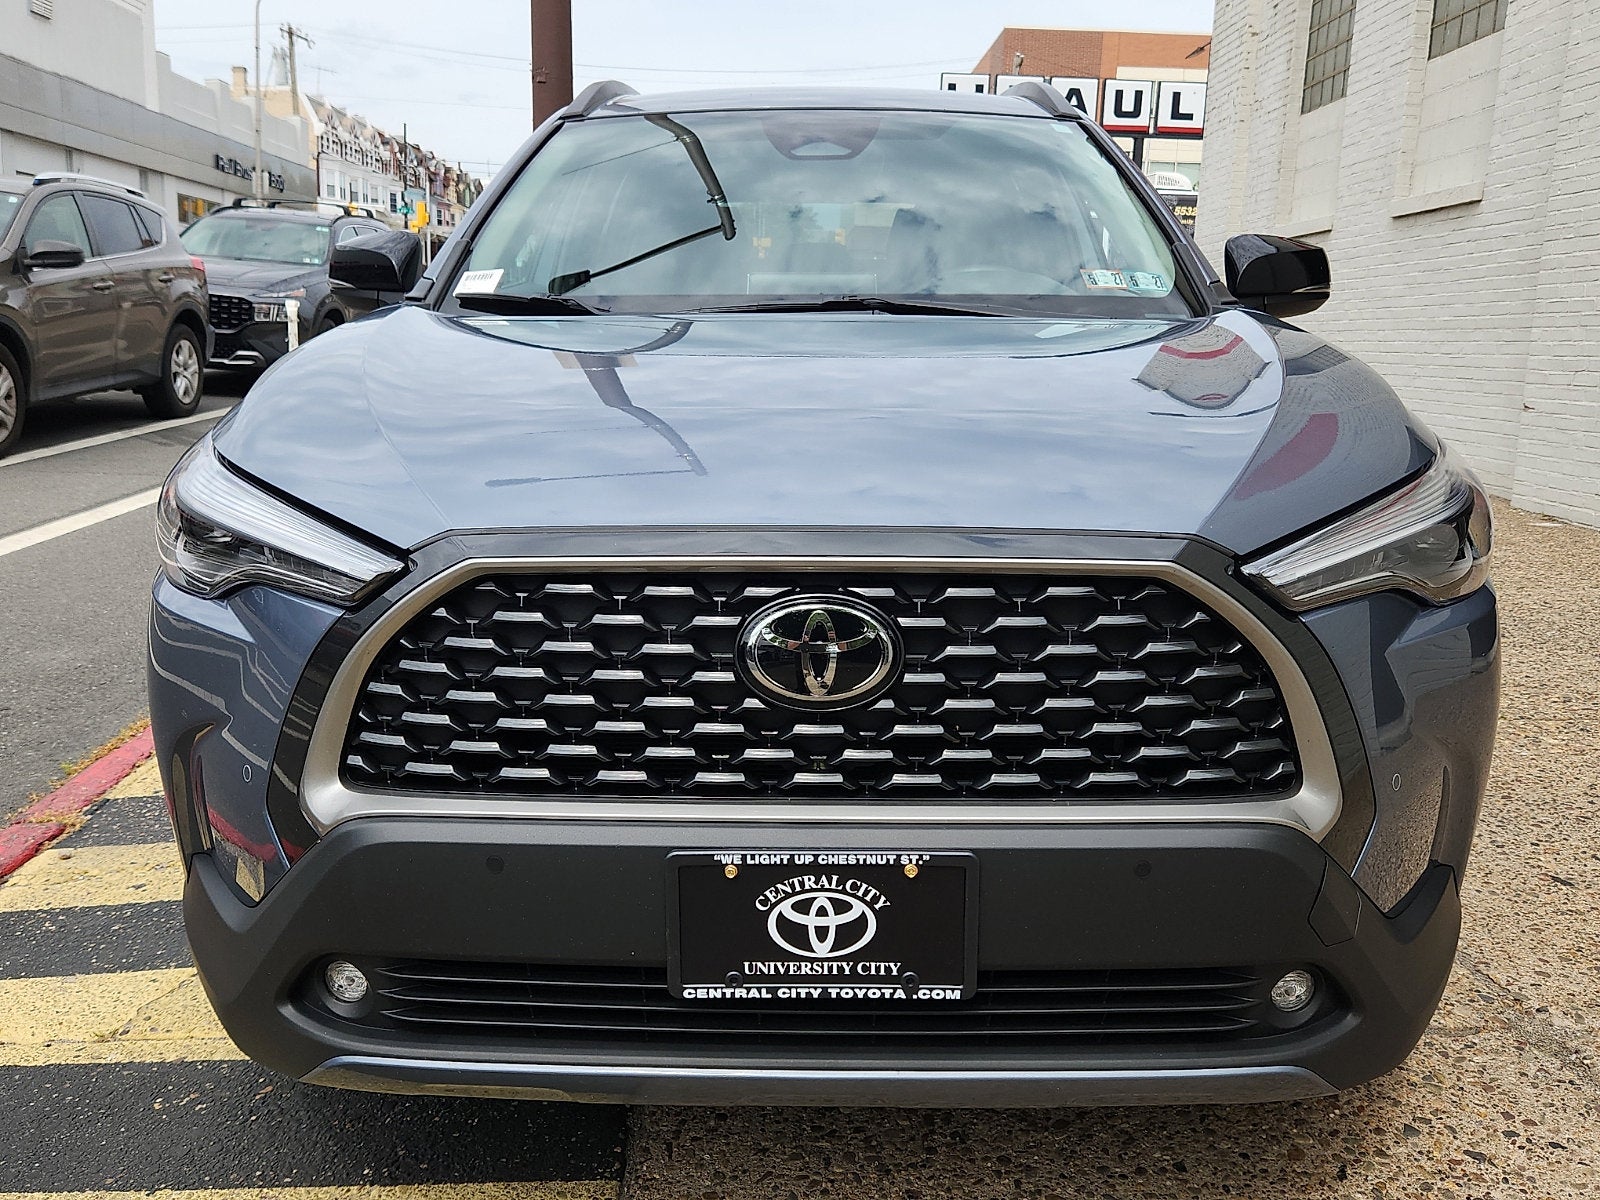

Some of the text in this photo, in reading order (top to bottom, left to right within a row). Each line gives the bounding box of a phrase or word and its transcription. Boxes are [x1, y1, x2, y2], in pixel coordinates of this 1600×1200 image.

[1088, 274, 1098, 286] 5
[1129, 275, 1139, 288] 5
[746, 854, 790, 865] LIGHT
[794, 854, 815, 865] UP
[817, 854, 897, 865] CHESTNUT
[755, 874, 891, 911] CENTRAL CITY
[743, 961, 902, 976] UNIVERSITY CITY
[682, 988, 962, 1000] CENTRAL CITY TOYOTA .COM
